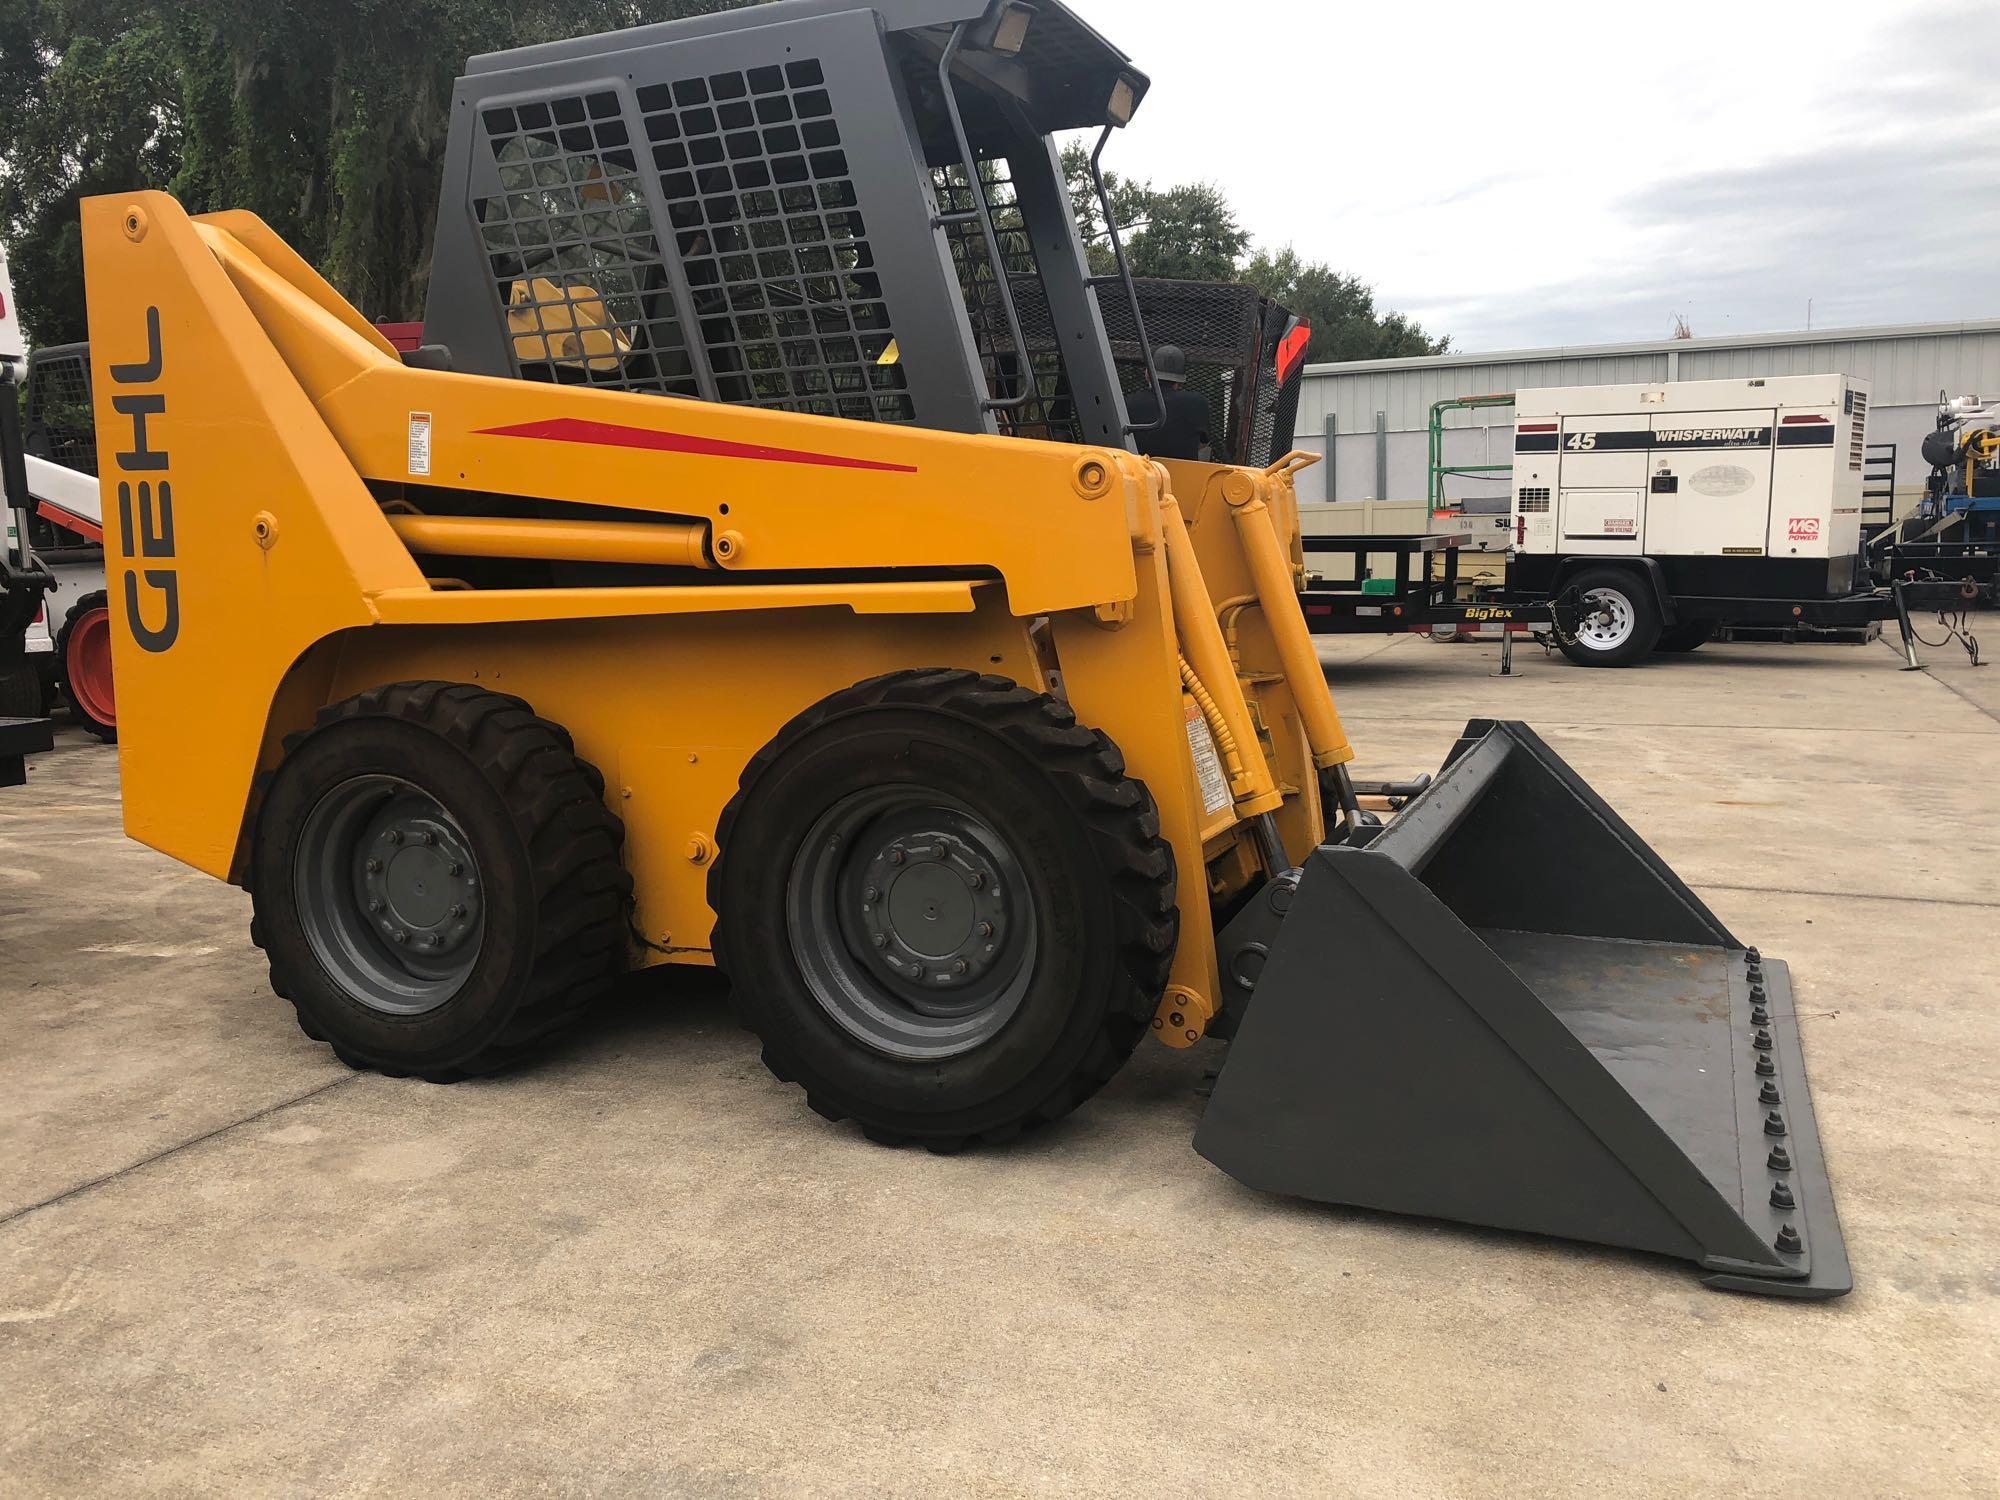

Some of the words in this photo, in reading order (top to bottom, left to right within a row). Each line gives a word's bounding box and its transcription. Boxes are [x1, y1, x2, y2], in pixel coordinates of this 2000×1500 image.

[1567, 432, 1597, 450] 45
[1655, 428, 1763, 442] WHISPERWATT
[109, 305, 180, 653] GEHL
[1788, 518, 1820, 534] MQ
[1464, 608, 1513, 620] BigTex
